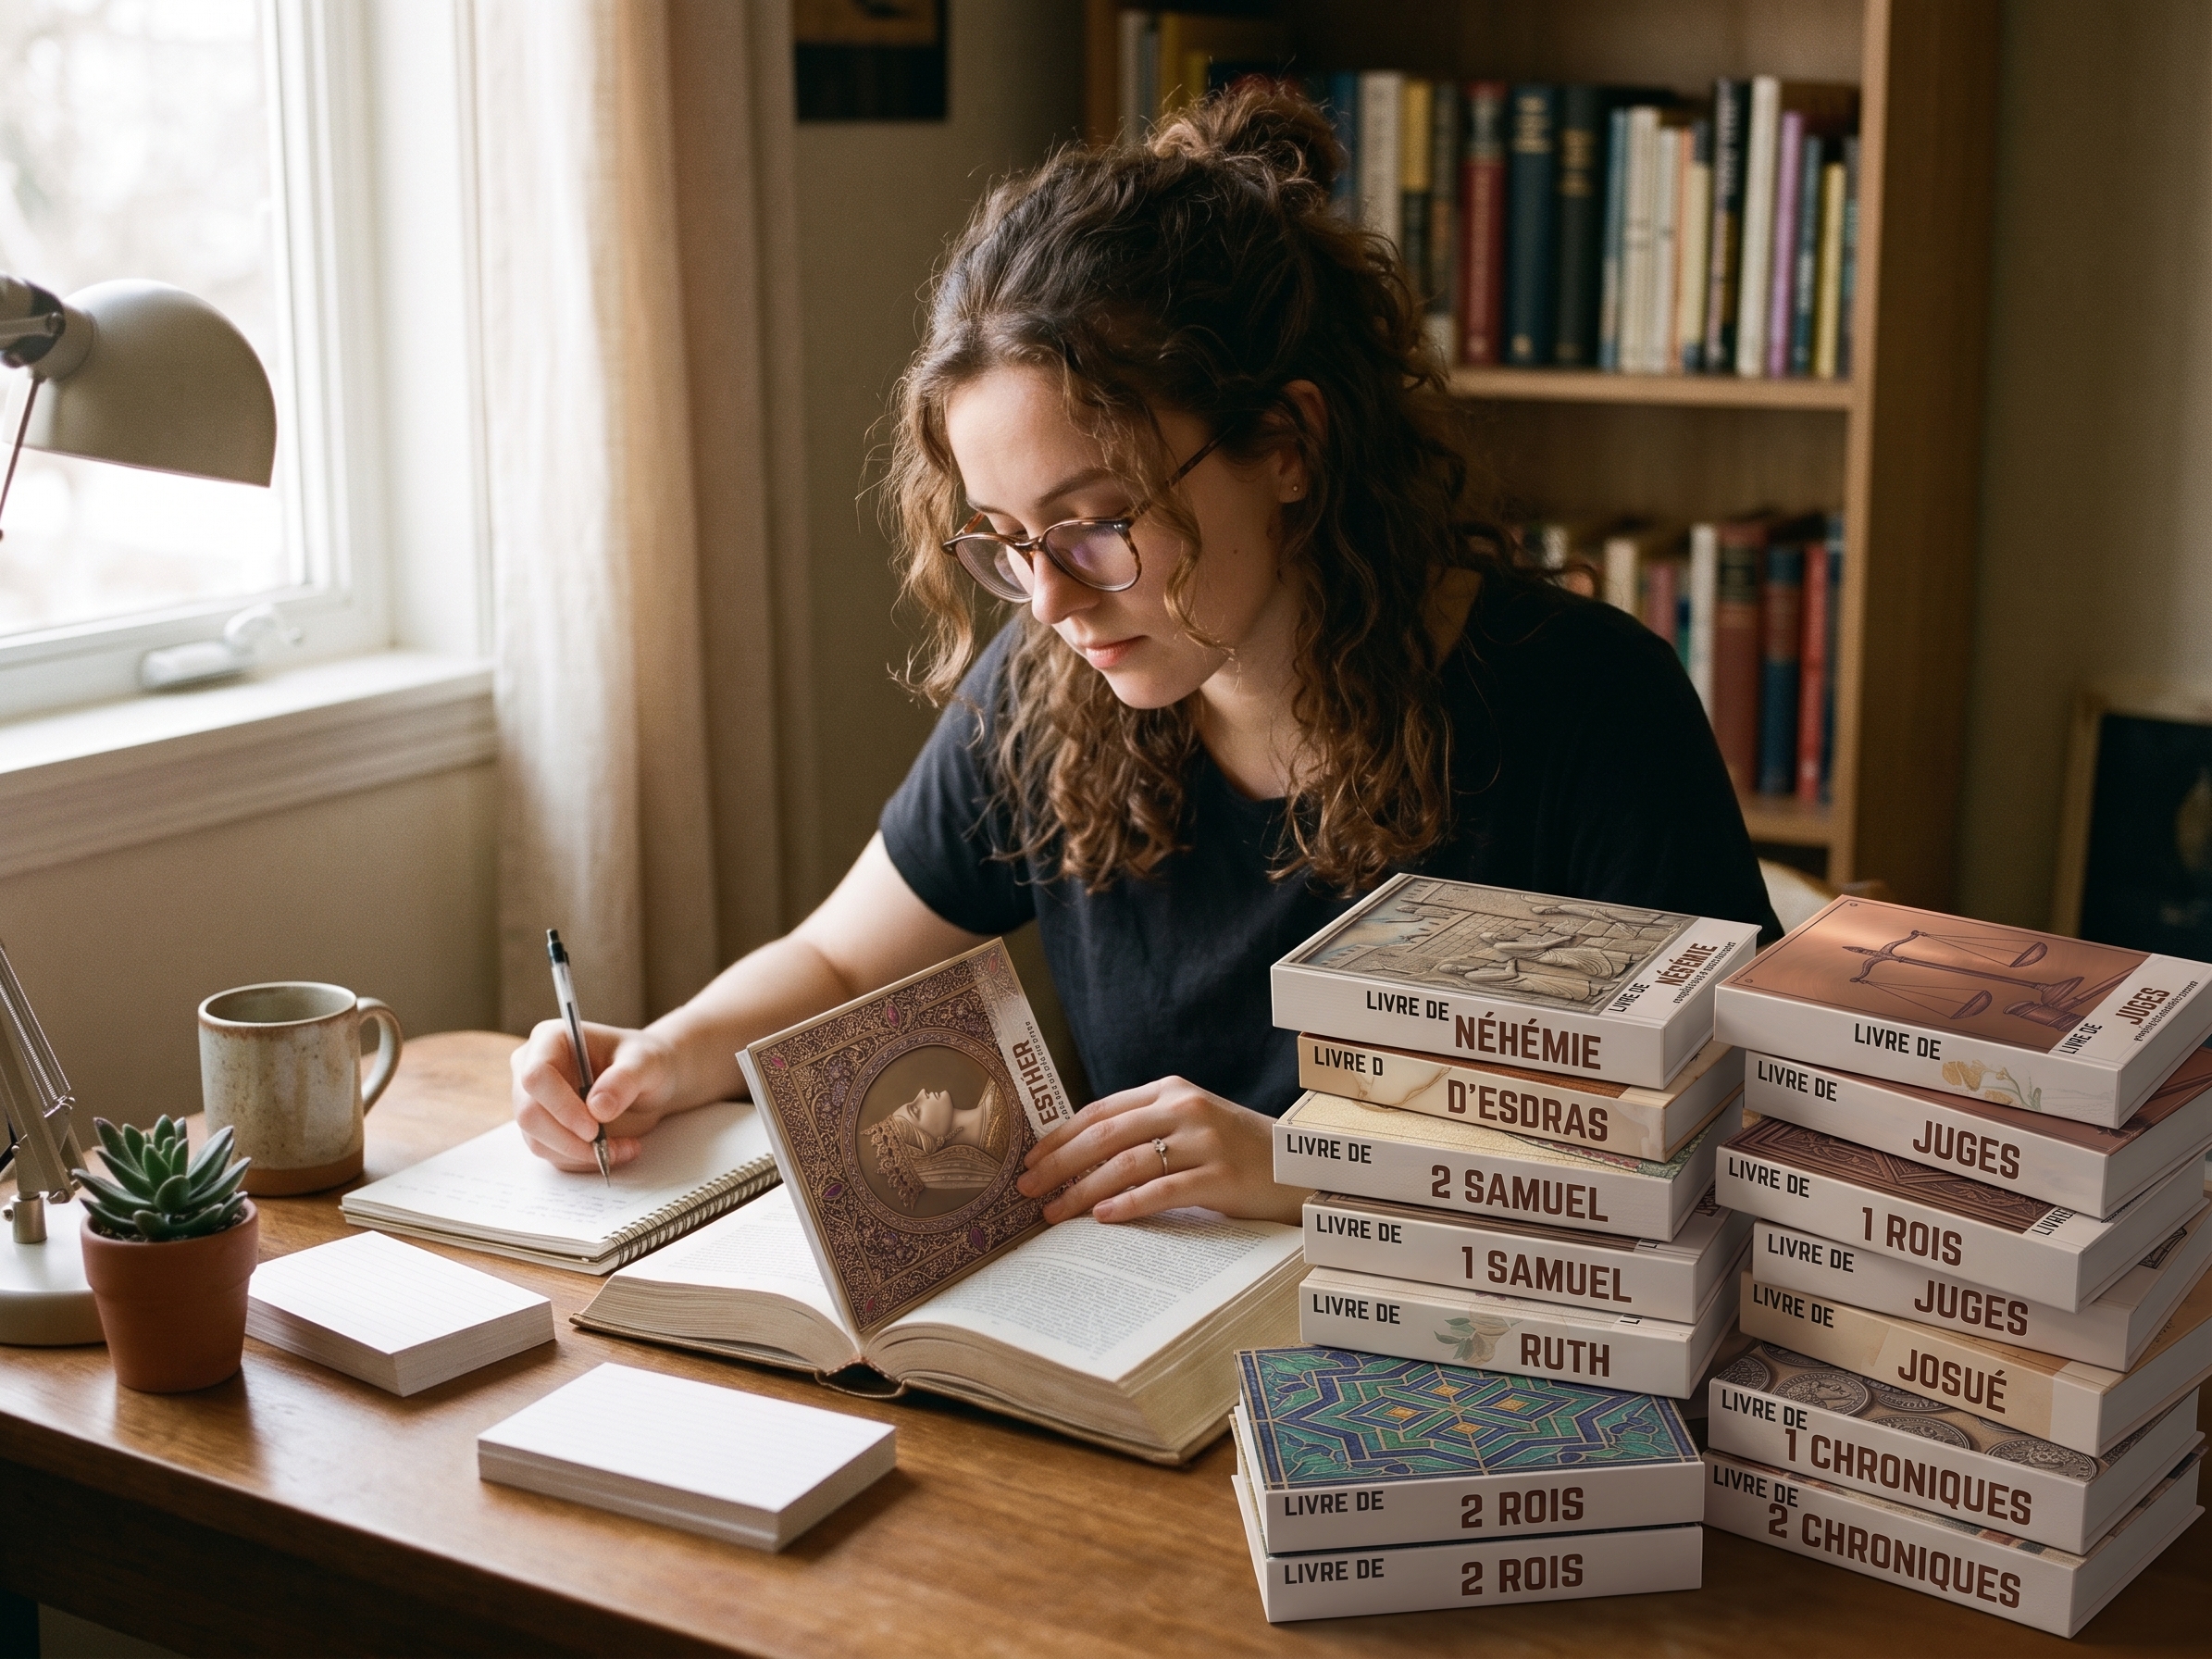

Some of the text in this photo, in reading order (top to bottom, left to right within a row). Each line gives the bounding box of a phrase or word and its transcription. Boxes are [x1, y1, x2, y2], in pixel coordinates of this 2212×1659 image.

[1367, 991, 1448, 1021] LIVRE DE
[1609, 983, 1650, 1012] LIVRE DE
[2116, 988, 2170, 1025] JUGES
[1455, 1011, 1600, 1071] NÉHÉMIE
[1855, 1023, 1941, 1060] LIVRE DE
[2059, 1023, 2103, 1054] LIVRE DE
[1315, 1045, 1383, 1076] LIVRE D
[1758, 1060, 1837, 1102] LIVRE DE
[1448, 1079, 1608, 1142] D'ESDRAS
[1287, 1134, 1371, 1164] LIVRE DE
[1912, 1120, 2019, 1179] JUGES
[1432, 1165, 1608, 1223] 2 SAMUEL
[1729, 1156, 1809, 1198] LIVRE DE
[1317, 1214, 1401, 1243] LIVRE DE
[1863, 1207, 1963, 1266] 1 ROIS
[1769, 1233, 1854, 1272] LIVRE DE
[1462, 1247, 1632, 1303] 1 SAMUEL
[1313, 1294, 1400, 1324] LIVRE DE
[1754, 1284, 1834, 1328] LIVRE DE
[1914, 1280, 2028, 1336] JUGES
[1521, 1333, 1609, 1378] RUTH
[1898, 1347, 2007, 1415] JOSUÉ
[1722, 1388, 1808, 1430] LIVRE DE
[1714, 1465, 1798, 1507] LIVRE DE
[1785, 1428, 2032, 1526] 1 CHRONIQUES
[1285, 1491, 1384, 1516] LIVRE DE
[1461, 1487, 1583, 1528] 2 ROIS
[1285, 1558, 1384, 1584] LIVRE DE
[1462, 1554, 1583, 1596] 2 ROIS
[1769, 1503, 2020, 1609] 2 CHRONIQUES
